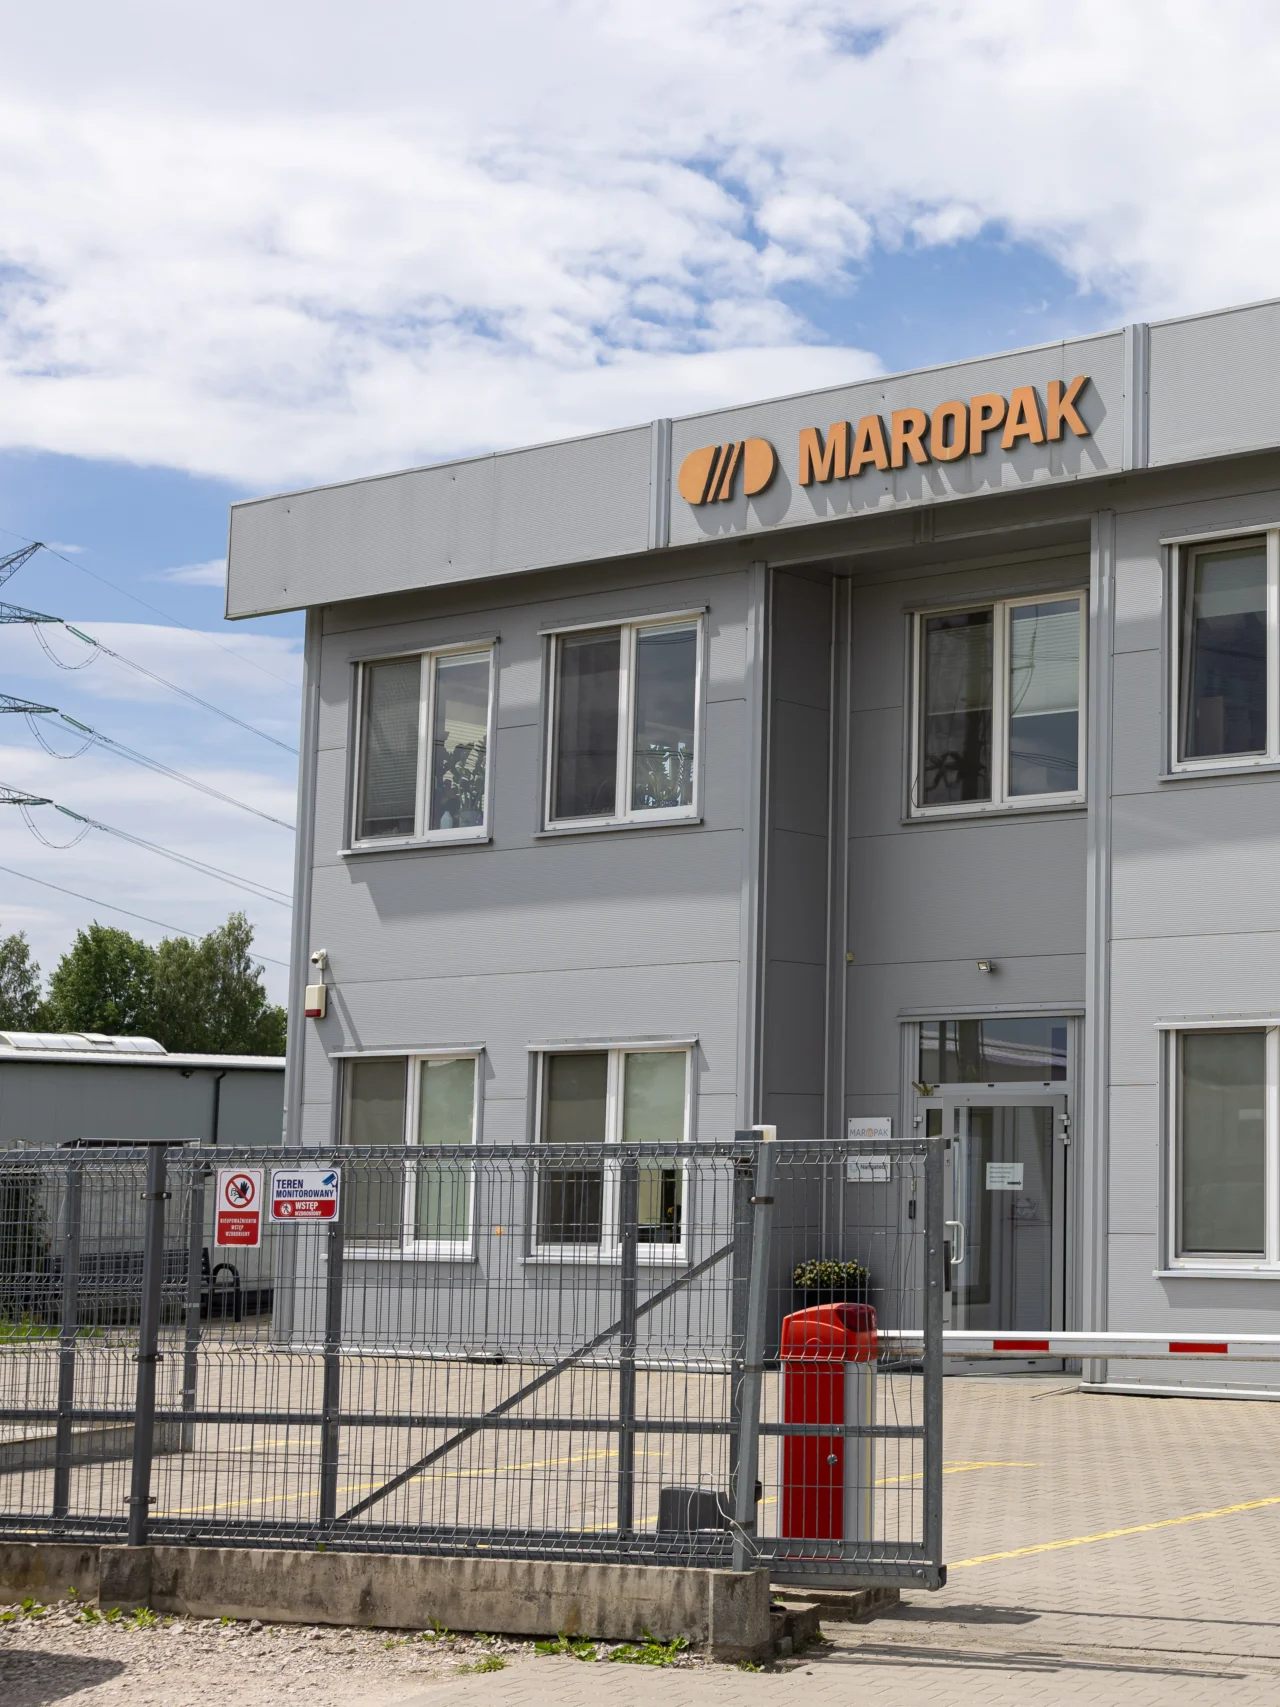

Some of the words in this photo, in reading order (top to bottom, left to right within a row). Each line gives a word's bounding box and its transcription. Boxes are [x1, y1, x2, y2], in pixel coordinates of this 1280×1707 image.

[798, 375, 1091, 486] MAROPAK
[276, 1179, 304, 1189] TEREN
[276, 1189, 334, 1198] MONITOROWANY
[295, 1201, 319, 1211] WSTĘP
